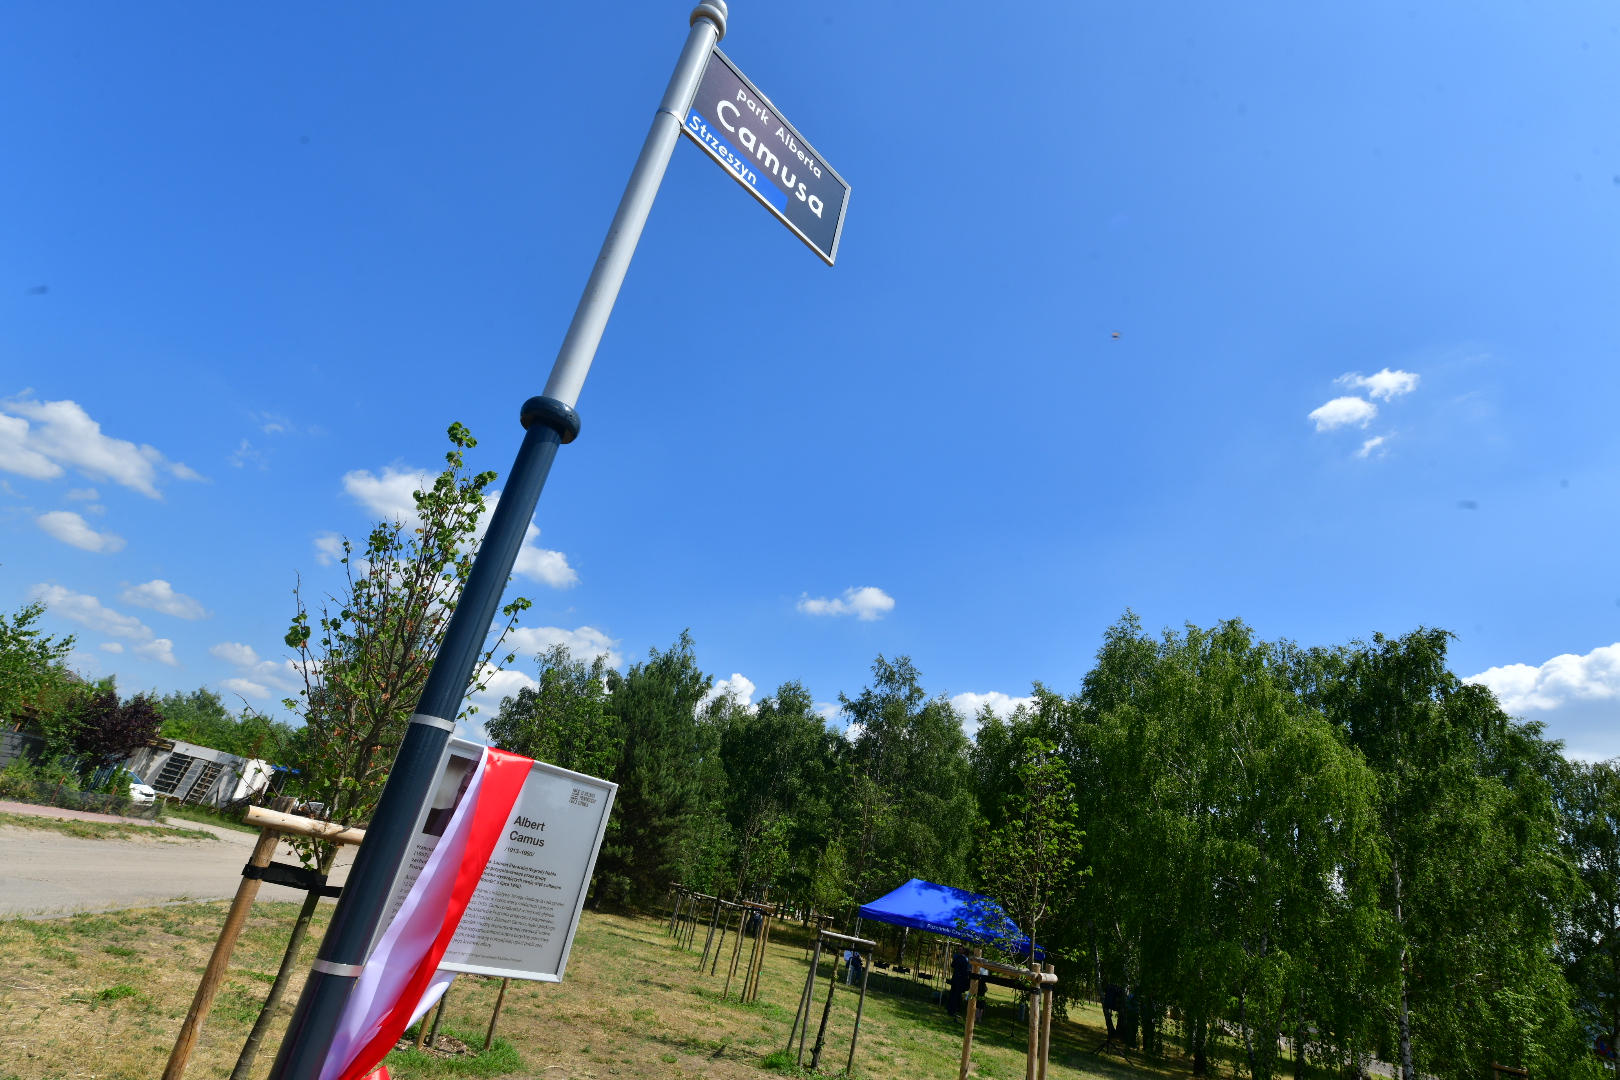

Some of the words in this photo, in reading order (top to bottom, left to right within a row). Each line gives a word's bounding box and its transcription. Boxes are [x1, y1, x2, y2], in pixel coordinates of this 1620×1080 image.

[688, 115, 757, 185] Strzeszyn
[716, 99, 824, 219] Camusa
[736, 89, 770, 125] park
[775, 126, 821, 180] Alberta
[509, 830, 545, 847] Camus
[513, 815, 545, 832] Albert
